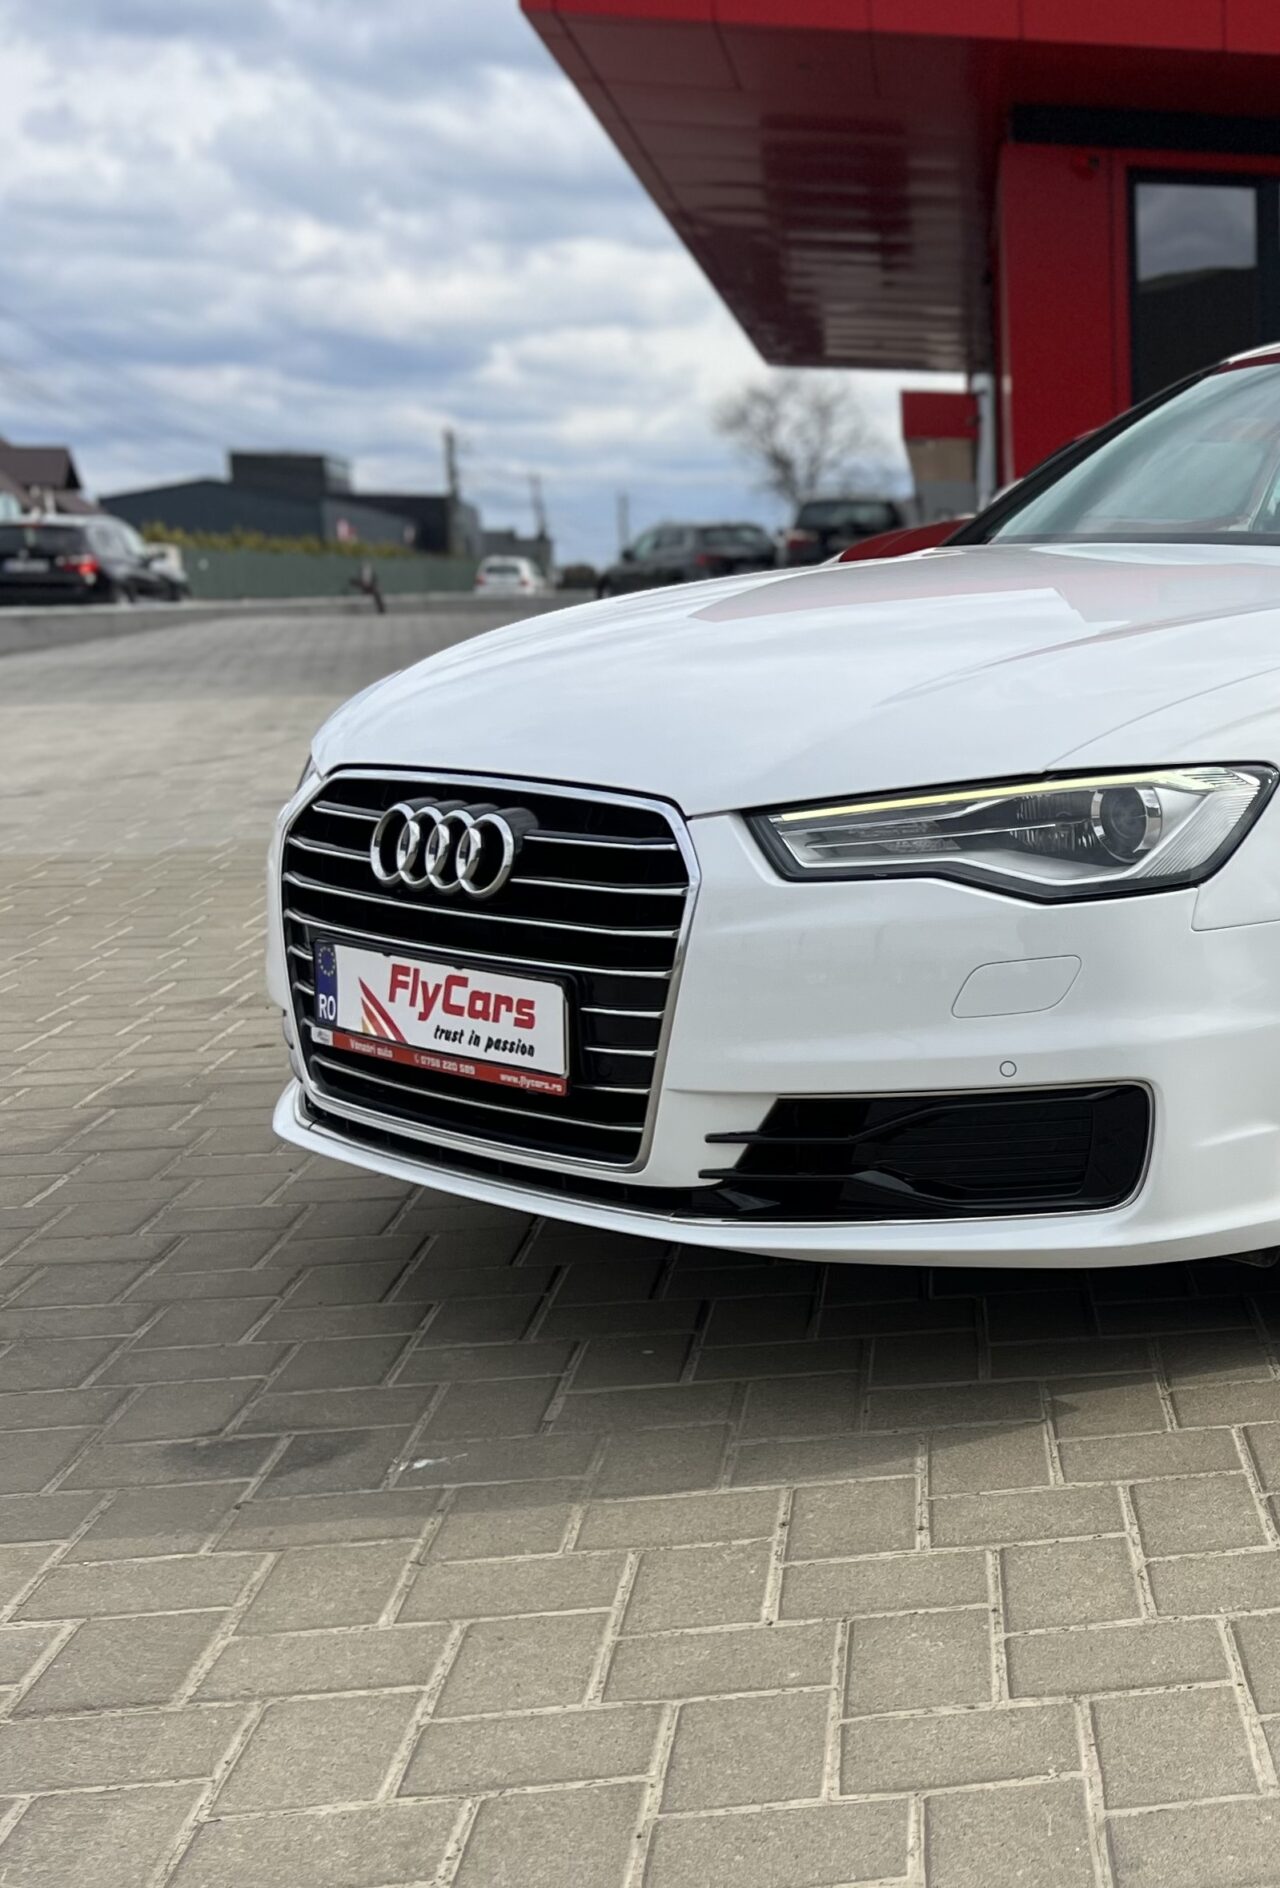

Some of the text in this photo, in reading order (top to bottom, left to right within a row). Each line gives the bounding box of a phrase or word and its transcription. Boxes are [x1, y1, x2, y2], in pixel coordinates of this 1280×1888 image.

[318, 993, 336, 1021] RO
[388, 963, 536, 1030] FlyCars
[434, 1024, 535, 1057] trust in passion
